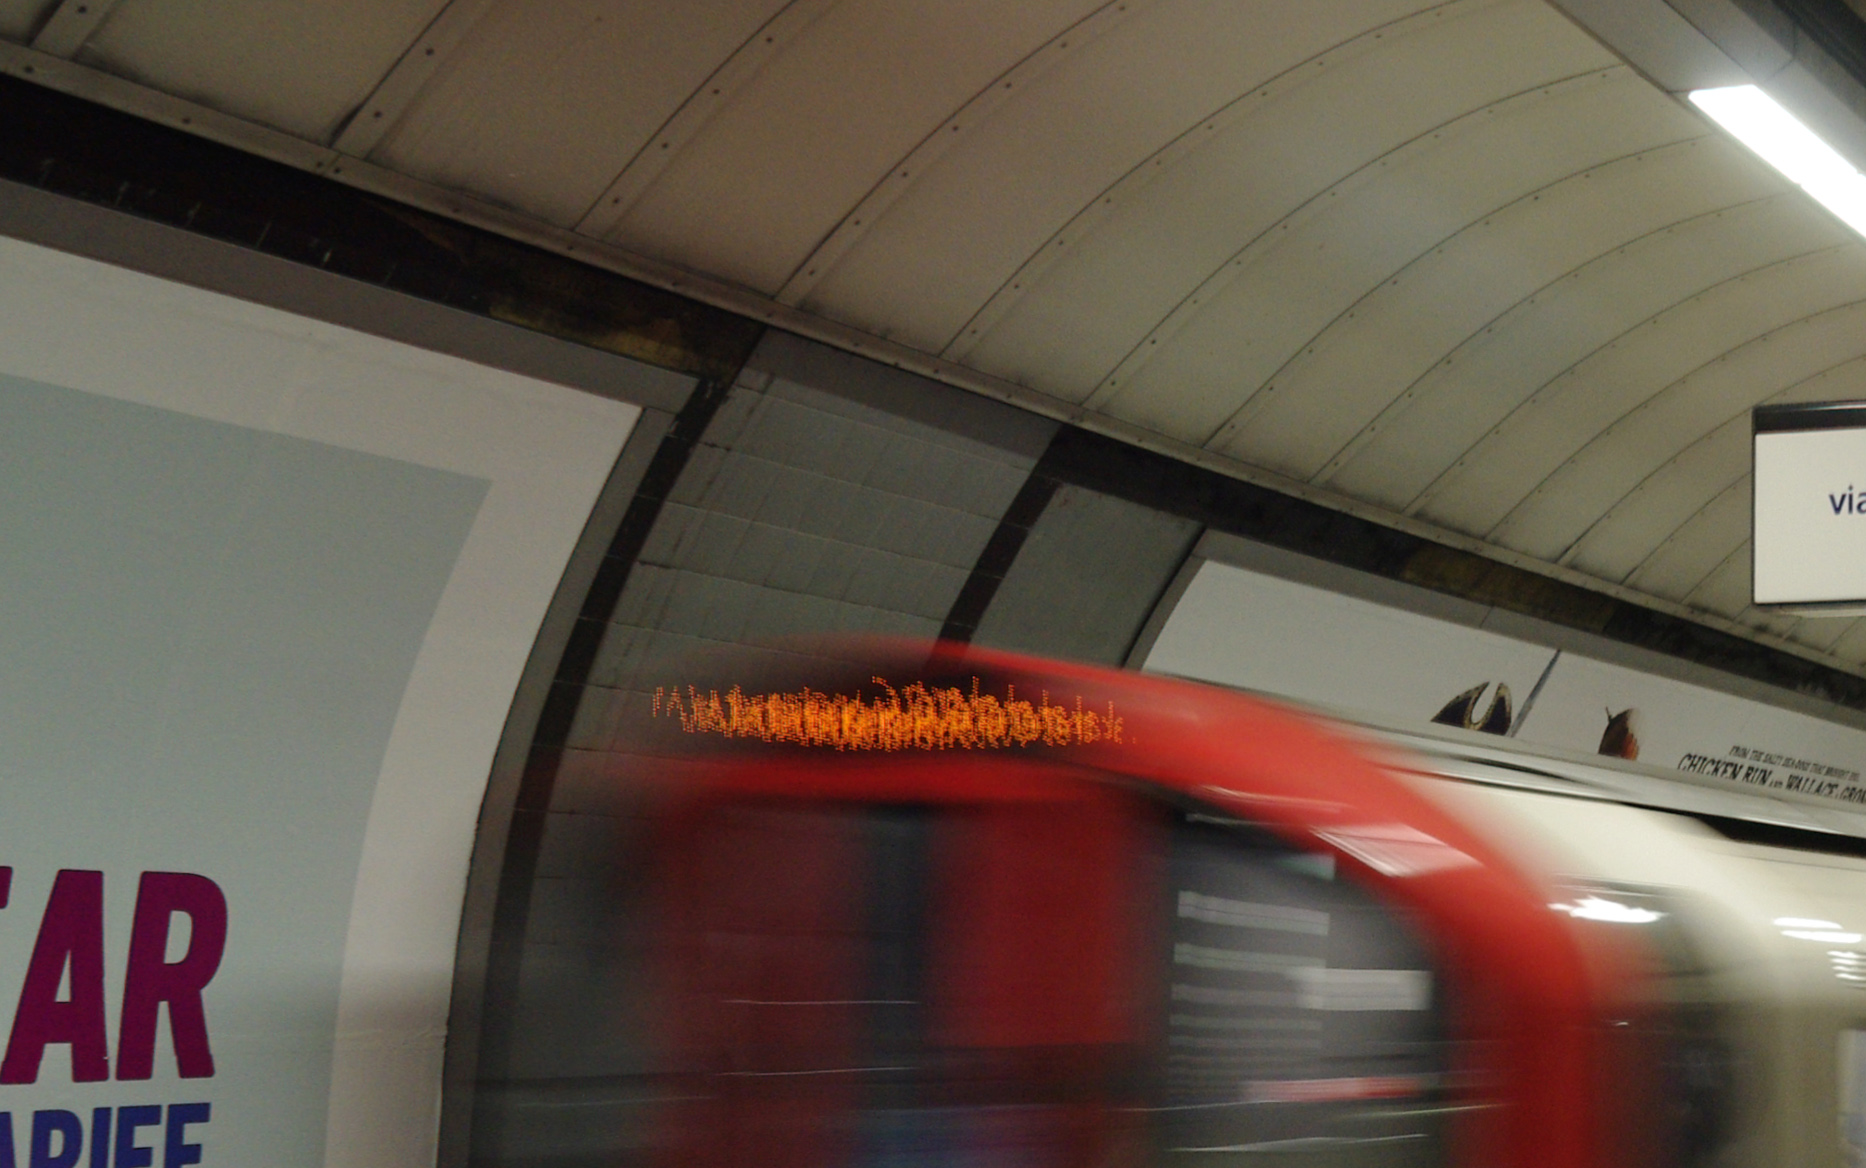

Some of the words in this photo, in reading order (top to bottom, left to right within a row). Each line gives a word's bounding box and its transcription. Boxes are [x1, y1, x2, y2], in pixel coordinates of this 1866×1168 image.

[1677, 753, 1744, 780] CHICKEN
[1741, 765, 1773, 788] RUN
[0, 866, 228, 1084] AR
